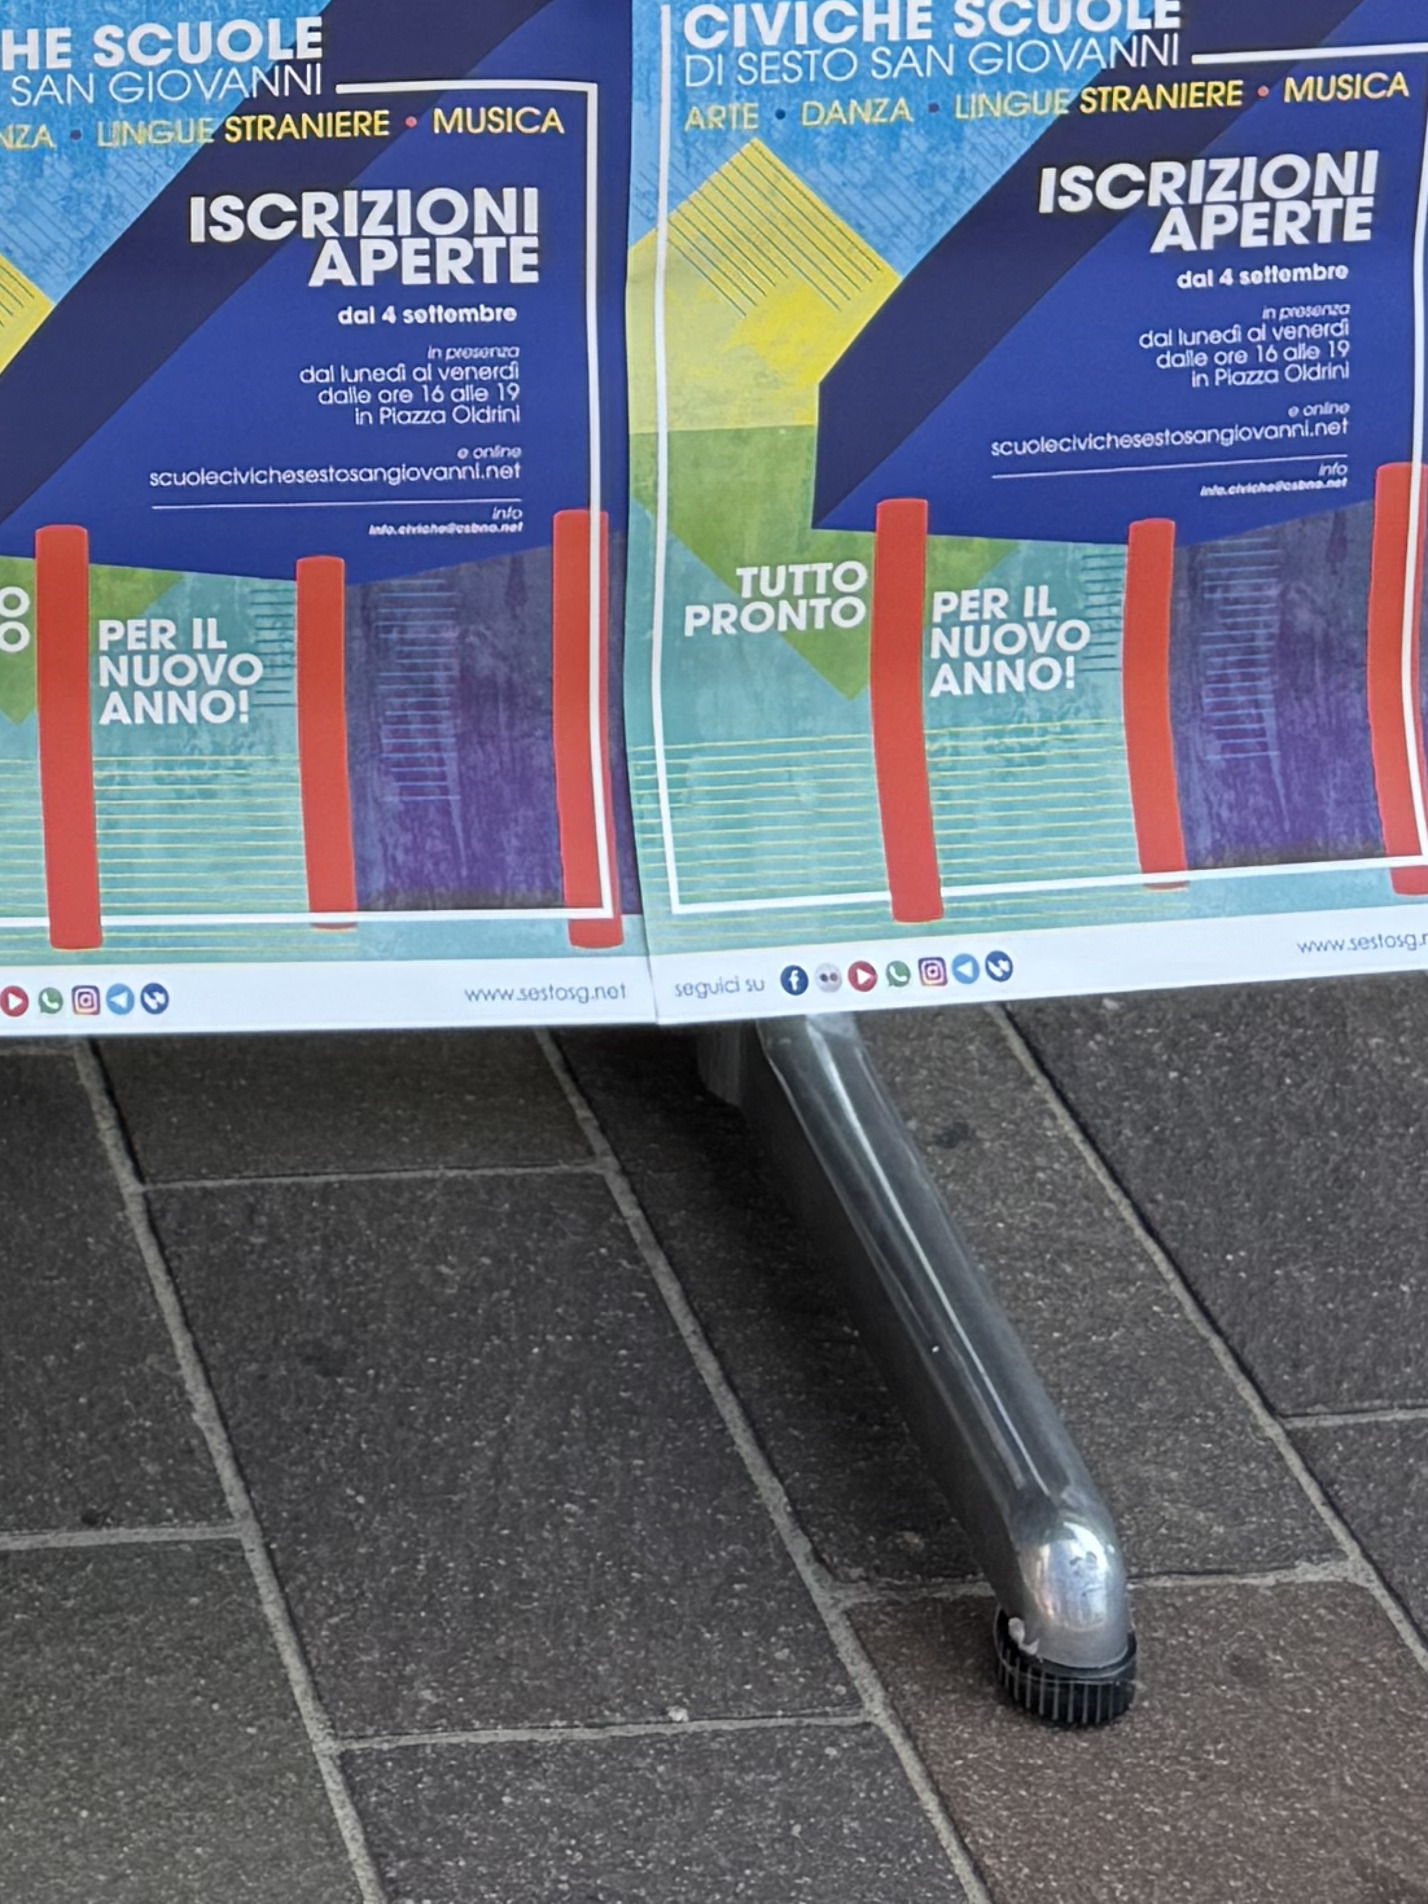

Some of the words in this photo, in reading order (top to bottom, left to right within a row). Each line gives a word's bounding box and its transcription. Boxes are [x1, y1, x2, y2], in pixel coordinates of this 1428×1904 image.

[92, 16, 323, 66] SCUOLE
[684, 52, 729, 87] DI
[735, 47, 857, 85] SESTO
[870, 42, 954, 79] SAN
[964, 33, 1179, 76] GIOVANNI
[10, 71, 95, 106] SAN
[103, 64, 323, 104] GIOVANNI
[1039, 150, 1377, 213] ISCRIZIONI
[188, 186, 540, 243] ISCRIZIONI
[1150, 196, 1373, 253] APERTE
[307, 235, 540, 288] APERTE
[734, 559, 868, 601] TUTTO
[683, 593, 867, 639] PRONTO
[932, 588, 1008, 625] PER
[1023, 584, 1058, 618] IL
[98, 618, 176, 653] PER
[191, 617, 227, 650] IL
[930, 616, 1091, 663] NUOVO
[98, 651, 264, 691] NUOVO
[929, 653, 1076, 699] ANNO!
[99, 688, 249, 726] ANNO!
